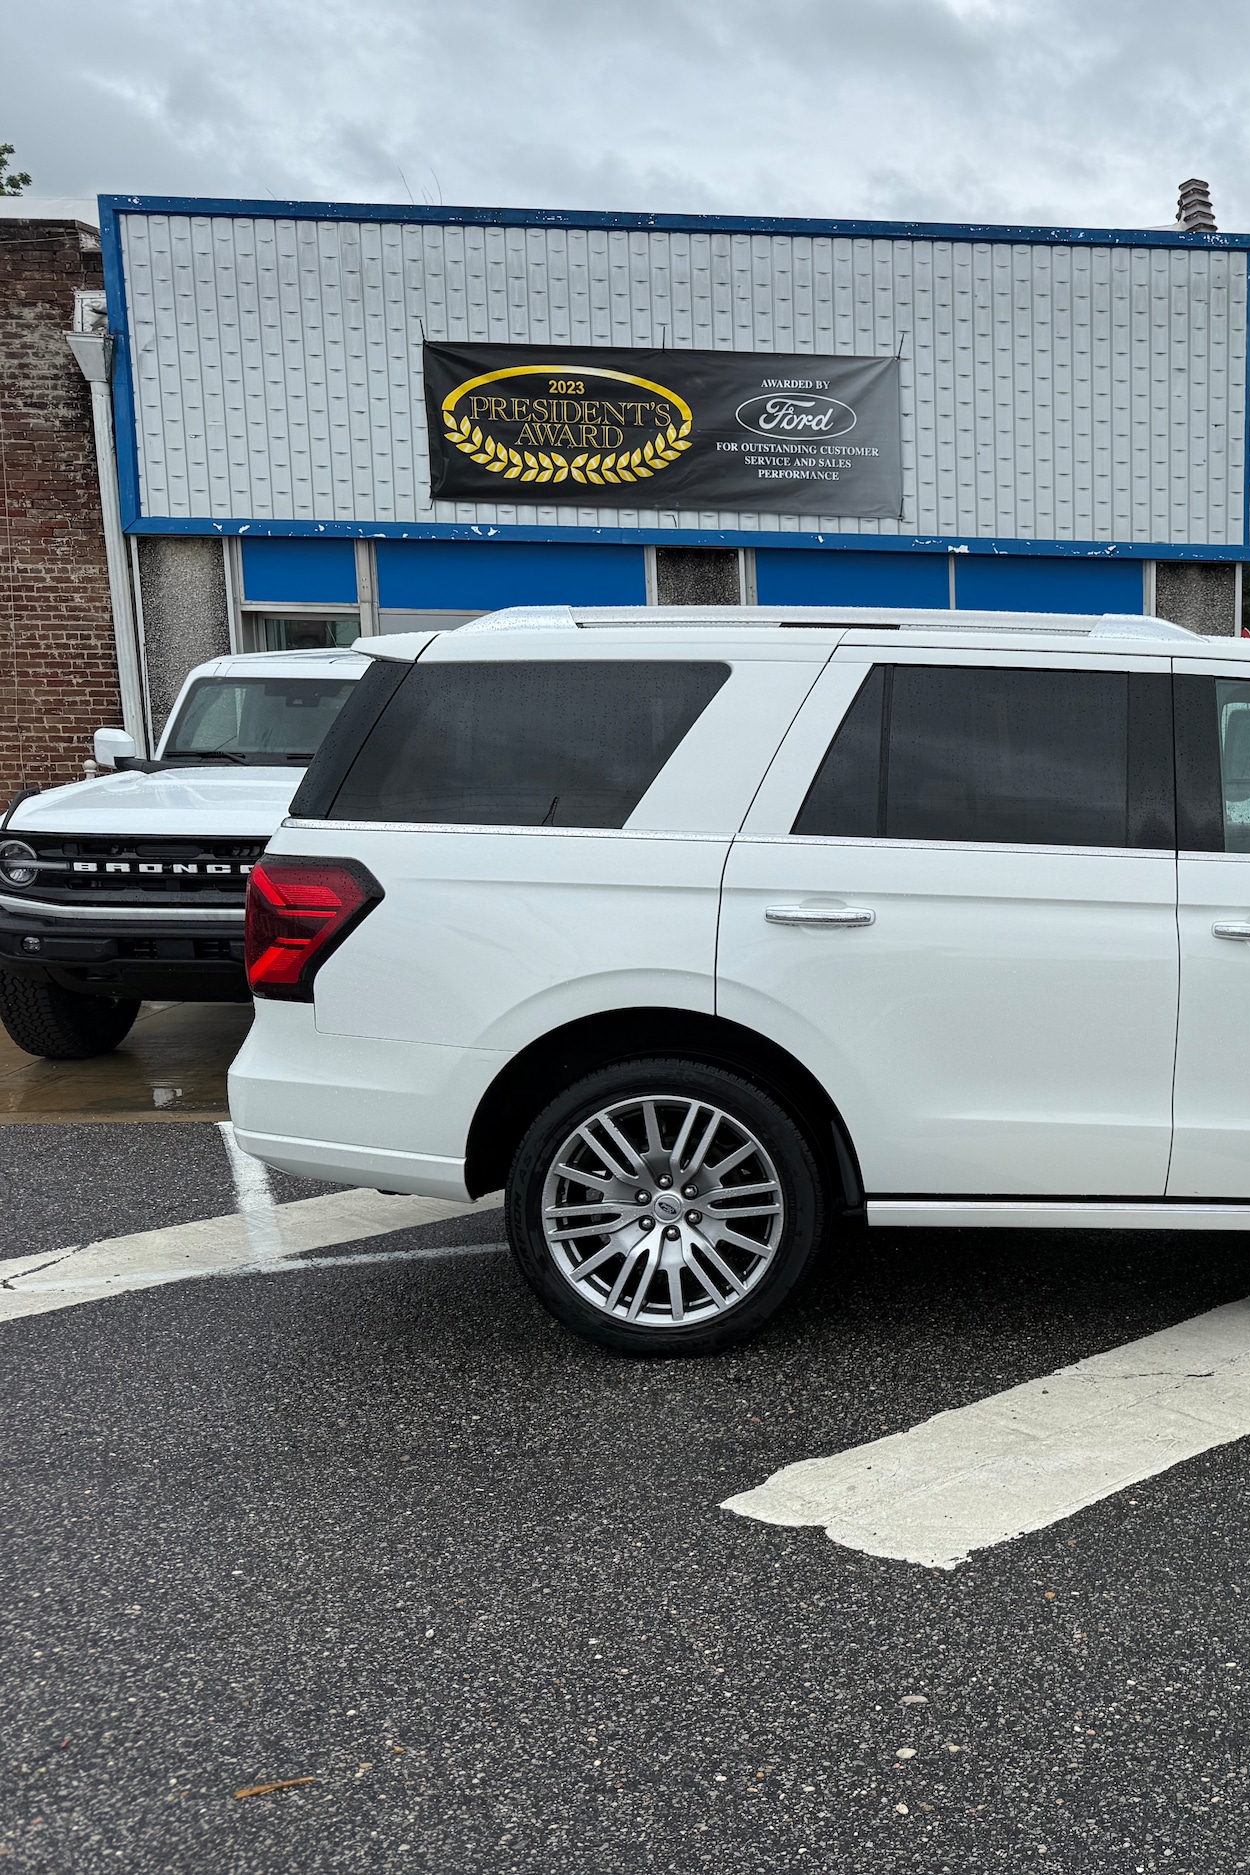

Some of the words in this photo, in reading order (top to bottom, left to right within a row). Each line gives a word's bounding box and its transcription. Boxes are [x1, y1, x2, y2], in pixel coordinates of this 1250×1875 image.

[548, 380, 586, 395] 2023
[761, 379, 813, 389] AWARDED
[816, 381, 830, 389] BY
[468, 396, 671, 427] PRESIDENT'S
[759, 398, 834, 431] Ford
[514, 422, 624, 449] AWARD
[716, 442, 739, 451] FOR
[741, 443, 817, 454] OUTSTANDING
[820, 446, 879, 456] CUSTOMER
[744, 456, 791, 466] SERVICE
[793, 458, 816, 467] AND
[818, 459, 852, 468] SALES
[758, 469, 840, 480] PERFORMANCE
